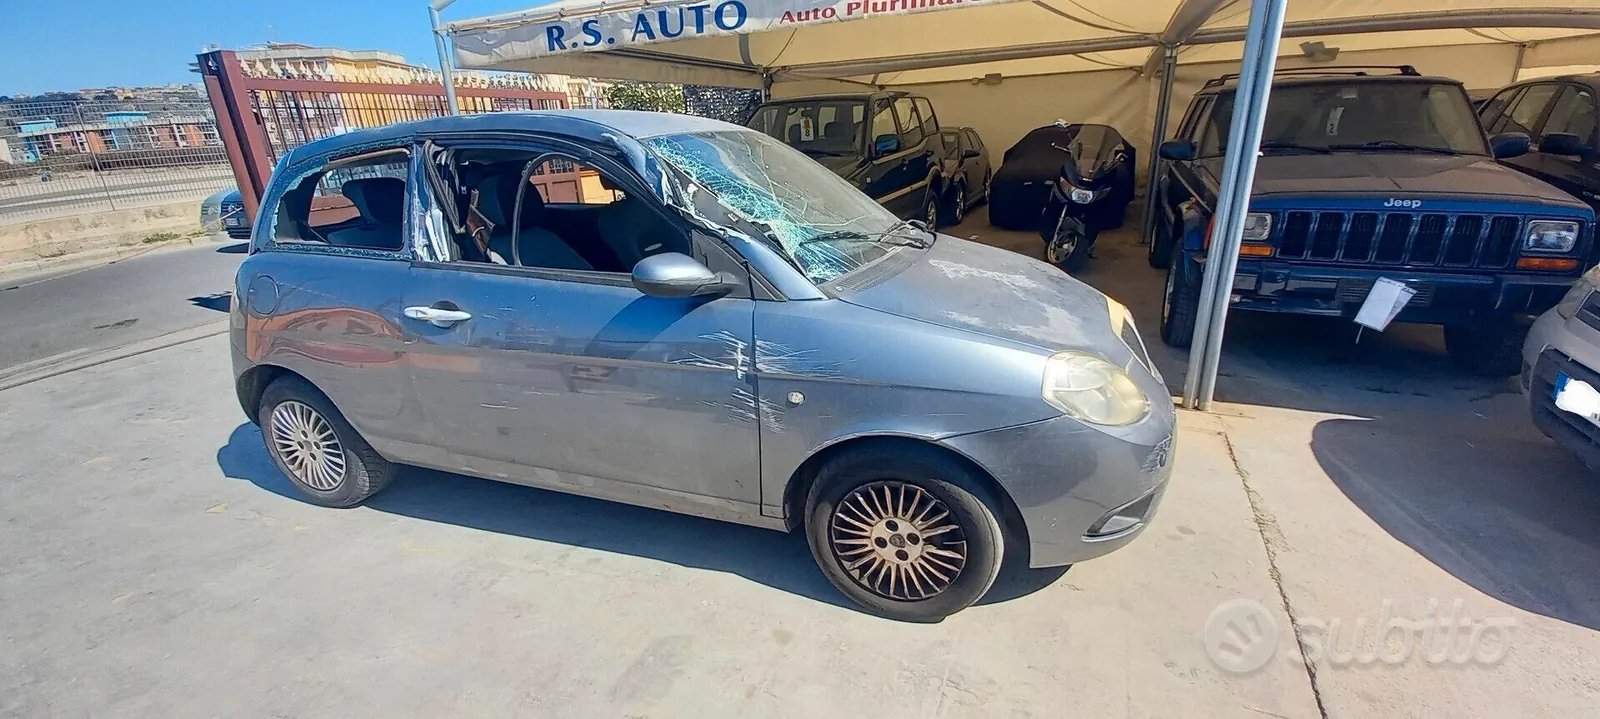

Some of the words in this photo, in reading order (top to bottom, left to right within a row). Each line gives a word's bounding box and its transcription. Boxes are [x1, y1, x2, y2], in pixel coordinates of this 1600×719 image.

[779, 7, 836, 24] Auto
[847, 0, 983, 16] Plurim
[546, 19, 615, 52] R.S.
[631, 0, 748, 42] AUTO
[1383, 197, 1422, 209] Jeep
